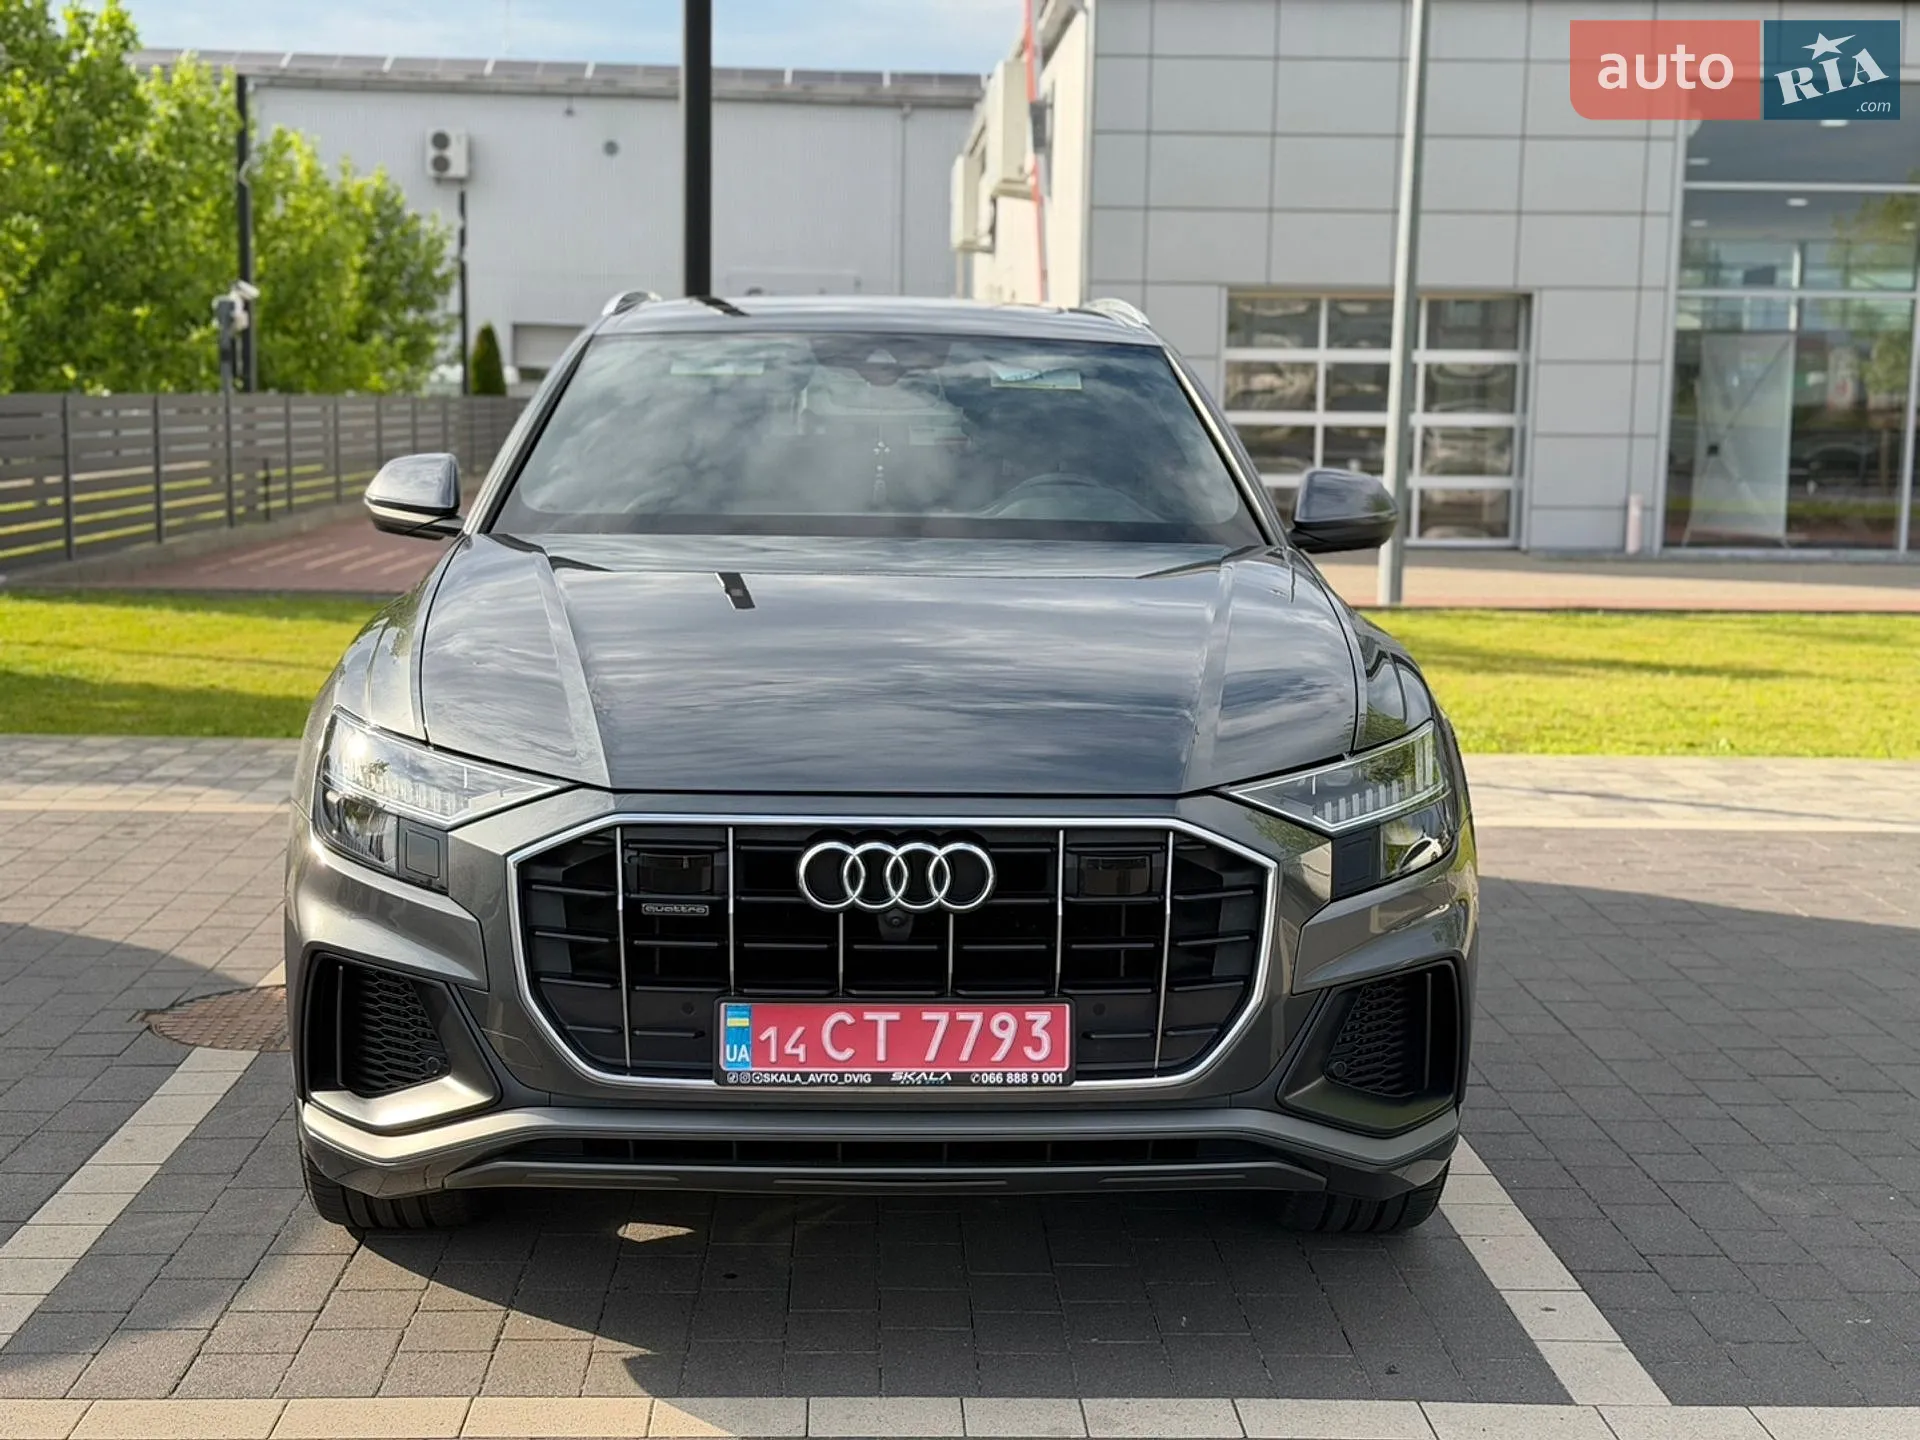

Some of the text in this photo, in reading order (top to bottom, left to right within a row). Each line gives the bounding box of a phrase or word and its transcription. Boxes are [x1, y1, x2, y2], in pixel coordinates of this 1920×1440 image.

[644, 904, 706, 914] quattro
[759, 1011, 1052, 1063] 14 CT 7793
[726, 1045, 750, 1062] UA
[762, 1073, 872, 1085] SKALA_AVTO_DVIG
[981, 1072, 1063, 1084] 066 888 9 001
